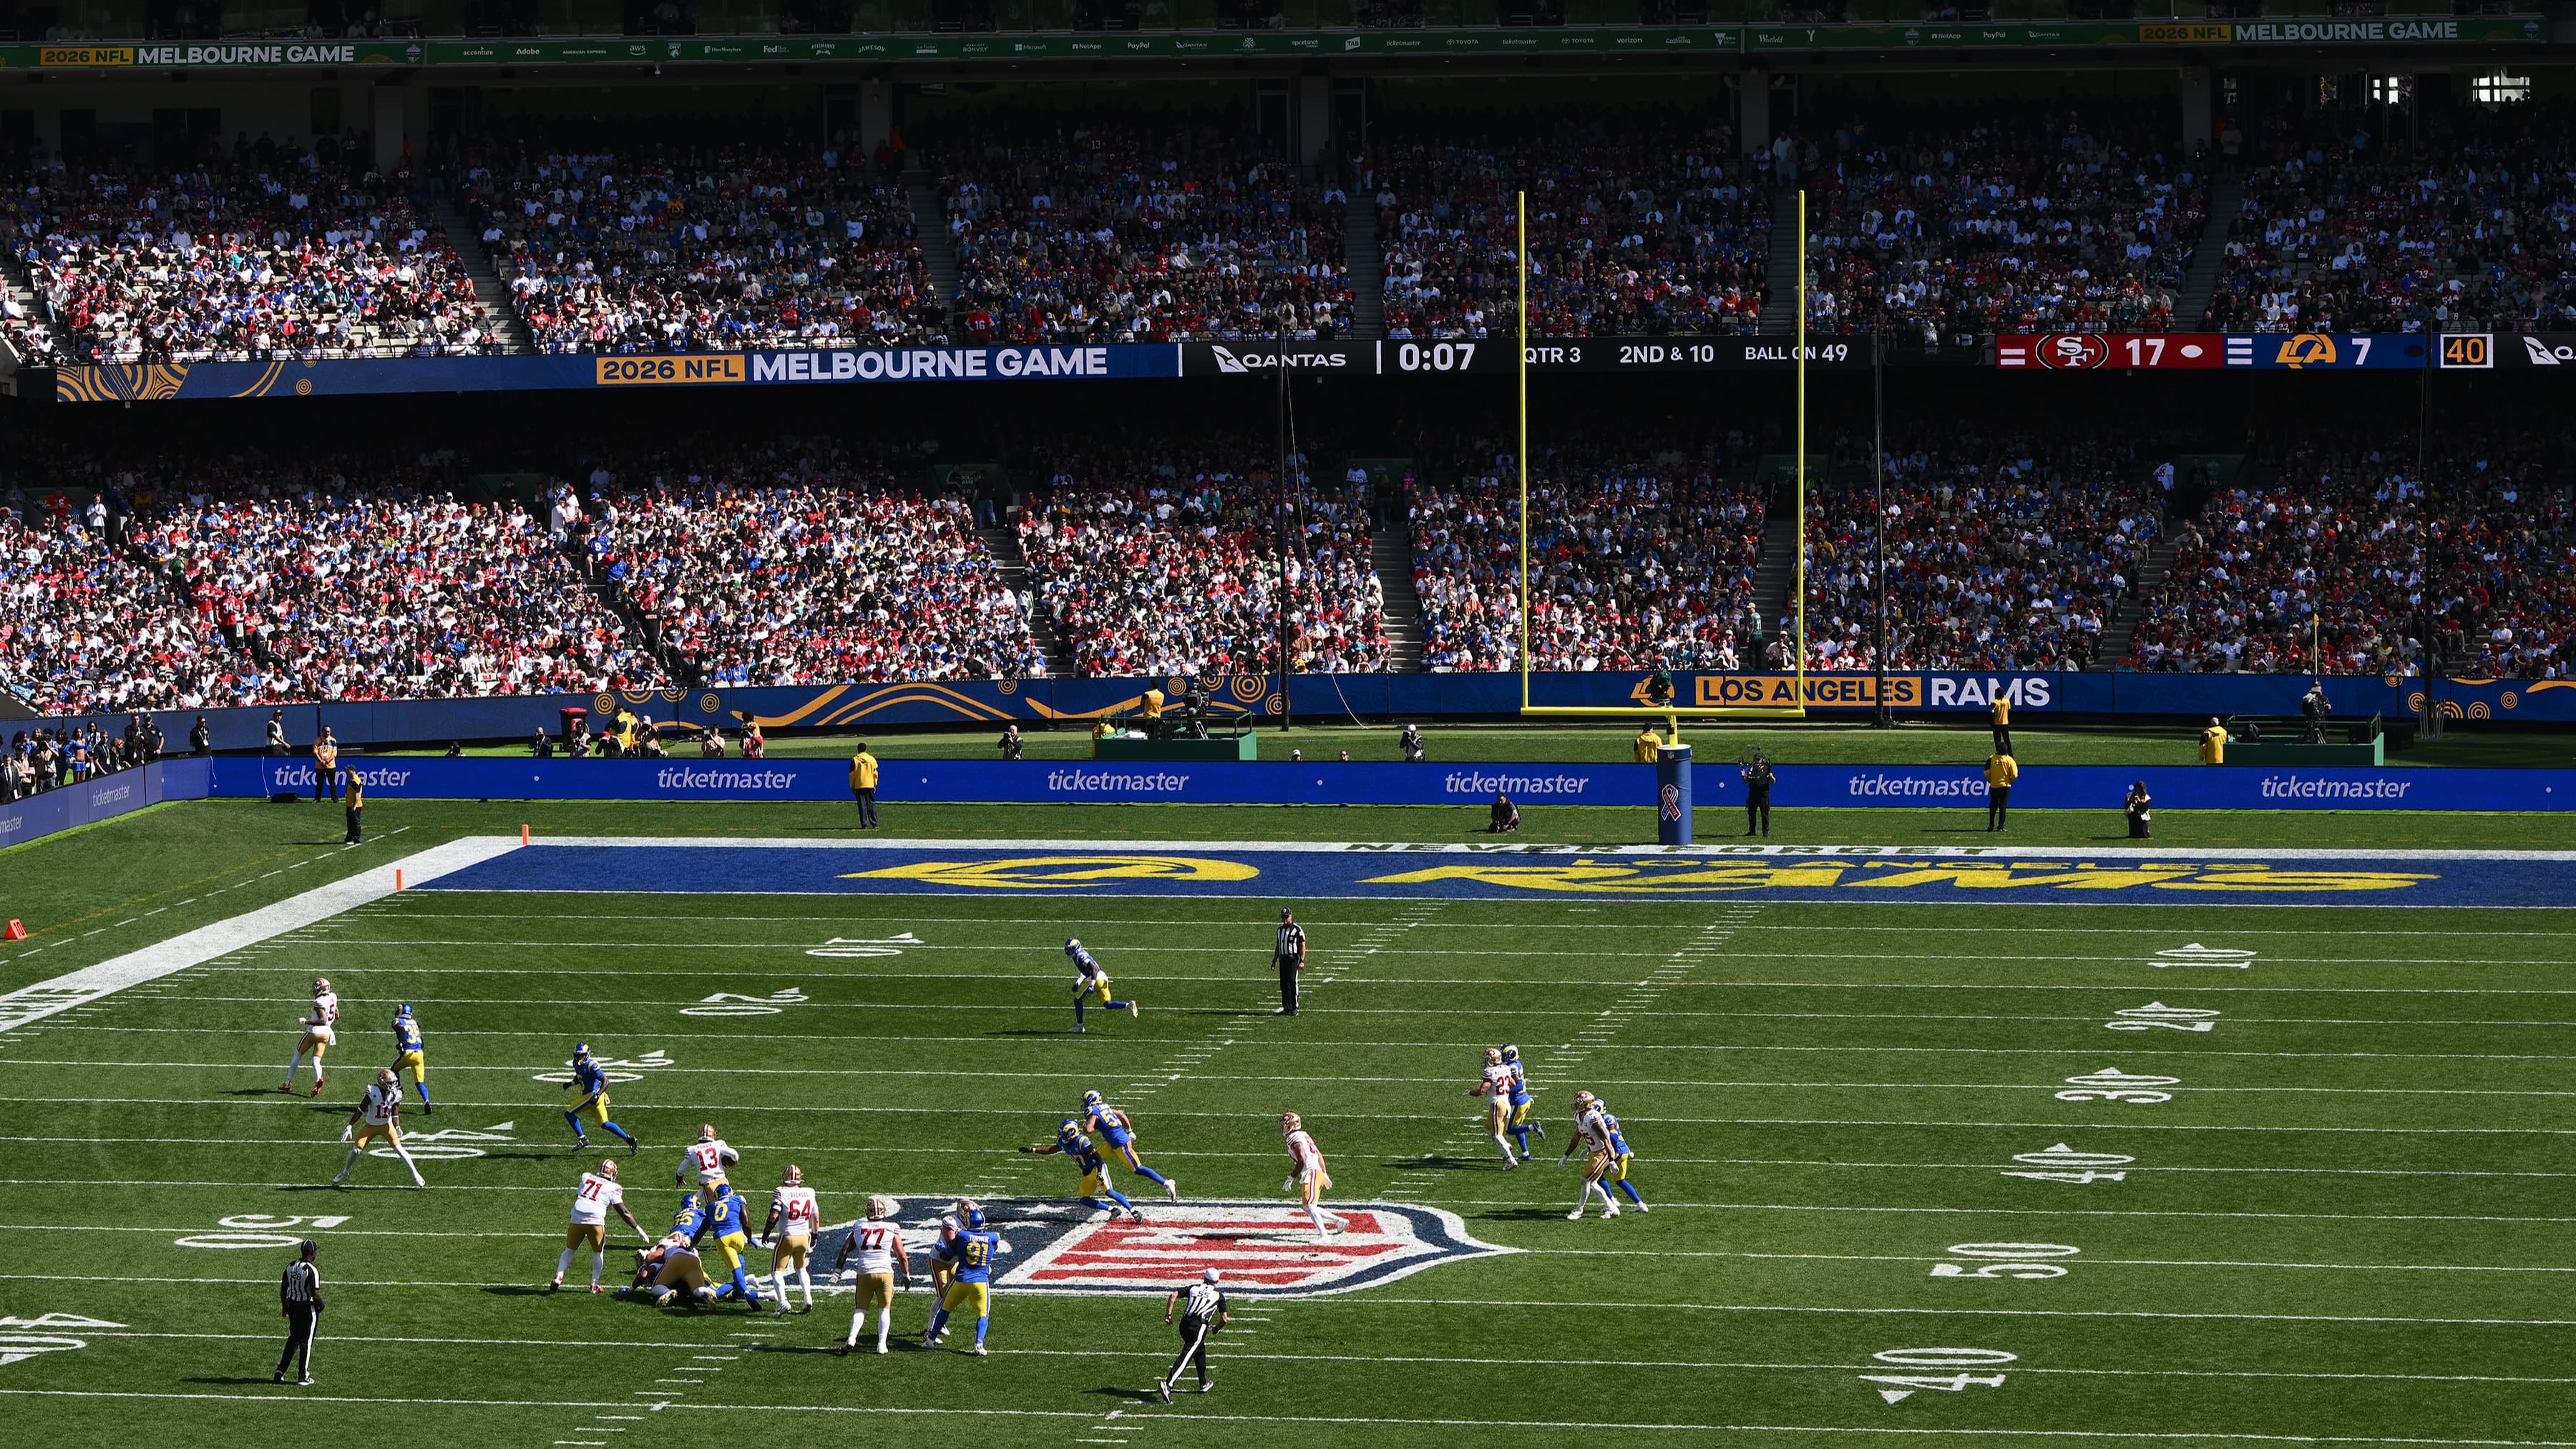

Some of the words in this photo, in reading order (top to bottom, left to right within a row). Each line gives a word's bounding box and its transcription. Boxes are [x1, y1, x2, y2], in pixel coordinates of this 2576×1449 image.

[2143, 28, 2189, 39] 2026
[2194, 27, 2228, 39] NFL
[2236, 24, 2384, 40] MELBOURNE
[2389, 22, 2457, 39] GAME
[44, 50, 90, 62] 2026
[95, 50, 130, 62] NFL
[138, 46, 281, 64] MELBOURNE
[286, 45, 355, 62] GAME
[1091, 140, 1101, 150] 13
[398, 170, 409, 179] 97
[2186, 210, 2199, 219] 97
[1279, 245, 1288, 255] 12
[766, 288, 773, 297] 12
[2391, 296, 2403, 306] 97
[2441, 296, 2453, 305] 54
[975, 319, 985, 331] 16
[2453, 312, 2459, 321] 8
[1242, 353, 1347, 368] QANTAS
[1399, 343, 1475, 371] 0:07
[1524, 347, 1563, 364] QTR
[1569, 346, 1581, 363] 3
[1619, 346, 1664, 364] 2ND
[1670, 346, 1683, 361] &
[1689, 345, 1714, 363] 10
[1745, 346, 1787, 360] BALL
[1792, 346, 1816, 360] ON
[1821, 343, 1848, 361] 49
[2125, 338, 2165, 366] 17
[2351, 338, 2372, 366] 7
[2446, 338, 2485, 364] 40
[603, 360, 675, 380] 2026
[685, 358, 738, 378] NFL
[753, 349, 987, 381] MELBOURNE
[995, 347, 1107, 376] GAME
[2278, 487, 2286, 496] 12
[1703, 679, 1764, 702] LOS
[1771, 680, 1914, 702] ANGELES
[1931, 677, 2051, 707] RAMS
[657, 766, 796, 789] ticketmaster
[1048, 769, 1190, 791] ticketmaster
[1445, 771, 1589, 794] ticketmaster
[2261, 775, 2411, 799] ticketmaster
[92, 784, 130, 808] ticketmaster
[1661, 845, 1999, 856] FORGET
[1571, 858, 1770, 868] LOS
[1788, 861, 2273, 871] ANGELES
[1353, 864, 2442, 893] RAMS
[13, 922, 26, 936] 10
[805, 937, 925, 957] 10
[2147, 948, 2258, 969] 10
[327, 1003, 336, 1022] 5
[679, 992, 810, 1016] 20
[2104, 1008, 2222, 1032] 20
[1496, 1075, 1511, 1096] 23
[2054, 1075, 2182, 1103] 30
[374, 1102, 391, 1119] 11
[368, 1129, 517, 1159] 40
[696, 1148, 719, 1172] 13
[2000, 1152, 2137, 1185] 40
[580, 1179, 603, 1202] 71
[713, 1203, 728, 1222] 0
[787, 1199, 810, 1221] 64
[173, 1214, 353, 1249] 50
[859, 1228, 886, 1250] 77
[969, 1234, 990, 1244] TURNER
[965, 1241, 990, 1267] 91
[1929, 1242, 2081, 1278] 50
[1196, 1290, 1211, 1299] 55
[1857, 1347, 2019, 1391] 40
